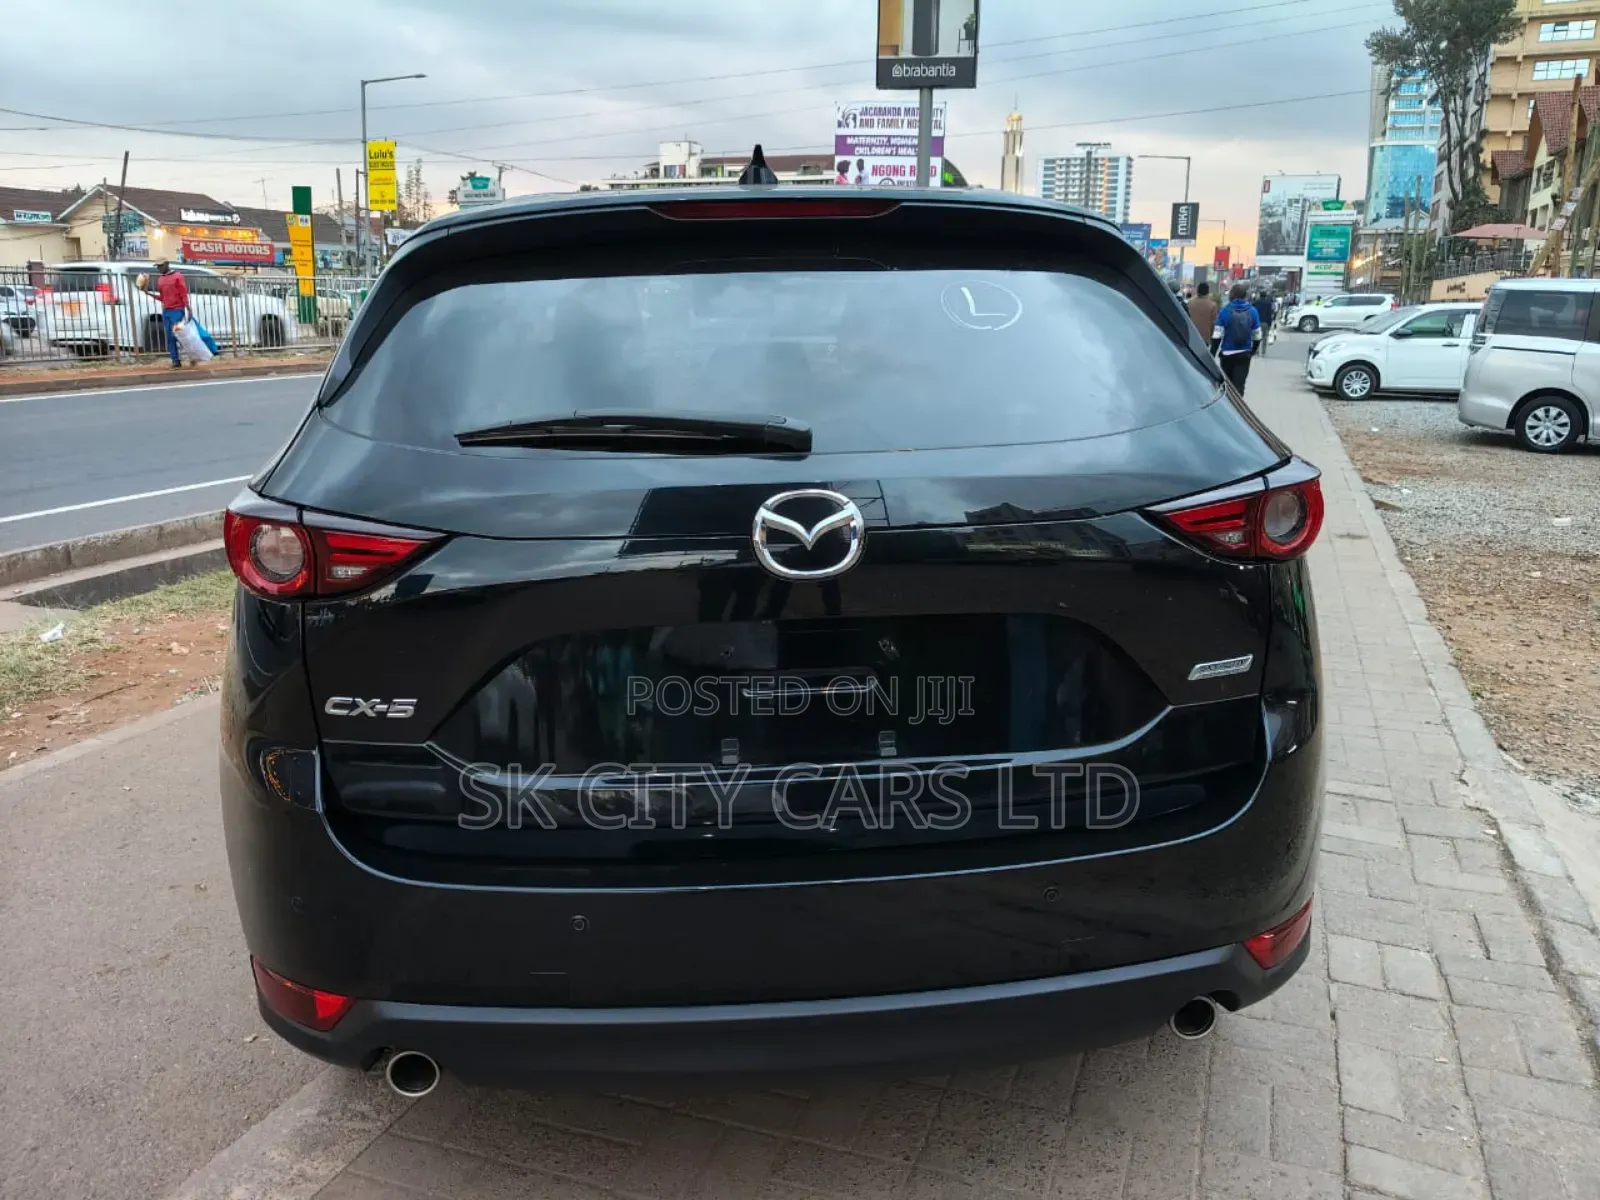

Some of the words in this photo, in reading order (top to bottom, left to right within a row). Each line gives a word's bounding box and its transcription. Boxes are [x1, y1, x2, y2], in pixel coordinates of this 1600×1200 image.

[903, 63, 956, 77] brabantia
[859, 106, 901, 117] JACARANDA
[903, 107, 943, 119] MATITY
[859, 118, 875, 129] AND
[877, 118, 905, 130] FAMILY
[369, 149, 394, 159] Lulu's
[871, 164, 906, 176] NGONG
[224, 243, 270, 255] MOTORS
[324, 696, 418, 718] CX-5
